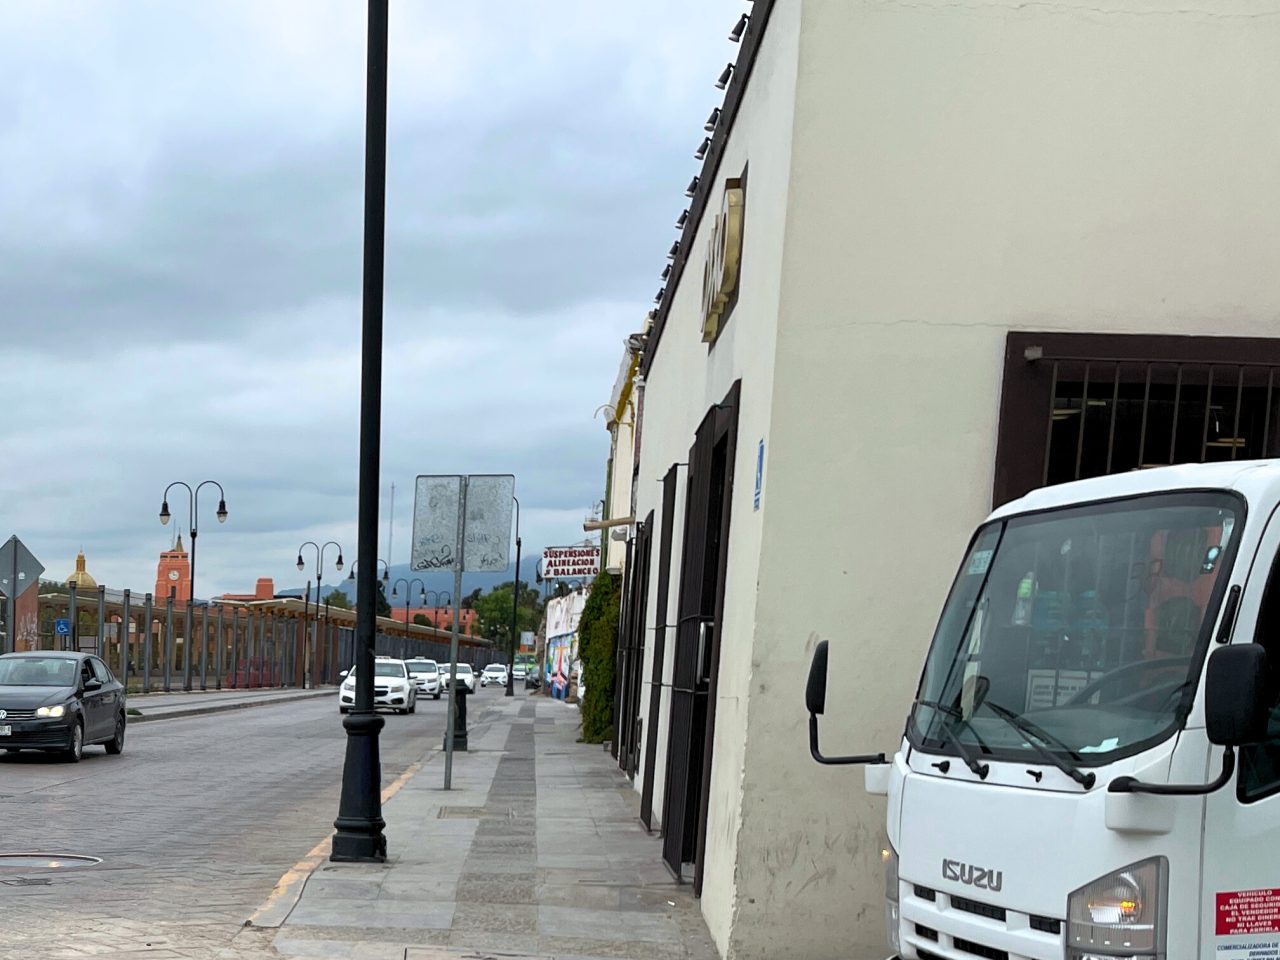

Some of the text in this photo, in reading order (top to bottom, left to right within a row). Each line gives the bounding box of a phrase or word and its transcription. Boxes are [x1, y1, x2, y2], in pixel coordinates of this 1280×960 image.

[544, 548, 600, 558] SUSPENSIONES
[547, 559, 595, 568] ALINEACION
[554, 568, 598, 576] BALANCEO
[942, 858, 1003, 892] ISUZU
[1229, 896, 1264, 904] EQUIPADO
[1239, 902, 1249, 910] DE
[1241, 907, 1279, 915] VENDEDOR
[1238, 914, 1256, 922] TRAE
[1246, 920, 1272, 928] LLAVES
